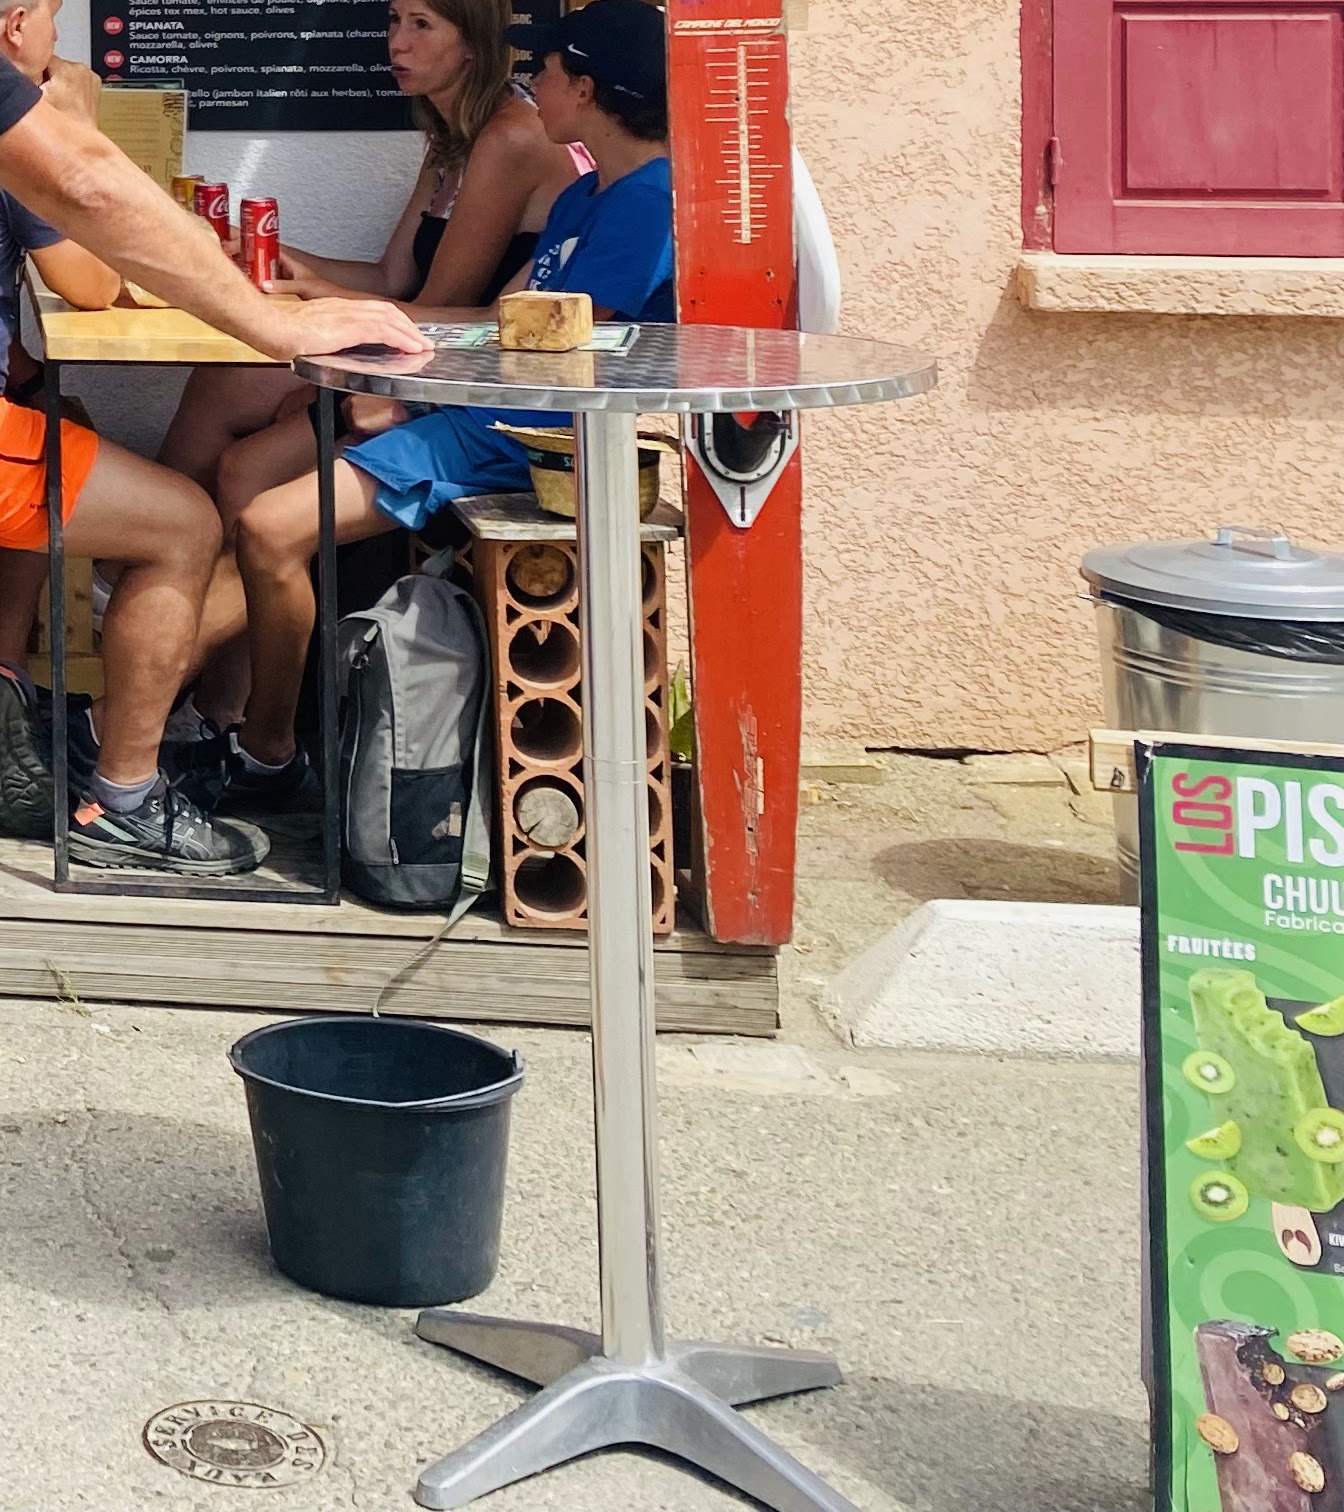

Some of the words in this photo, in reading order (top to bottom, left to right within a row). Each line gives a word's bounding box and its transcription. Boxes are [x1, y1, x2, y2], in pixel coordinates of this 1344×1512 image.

[129, 22, 184, 30] SPIANATA
[130, 55, 188, 64] CAMORRA
[199, 100, 248, 109] parmesan
[1172, 773, 1234, 856] LOS
[1167, 934, 1256, 962] FRUITÉES
